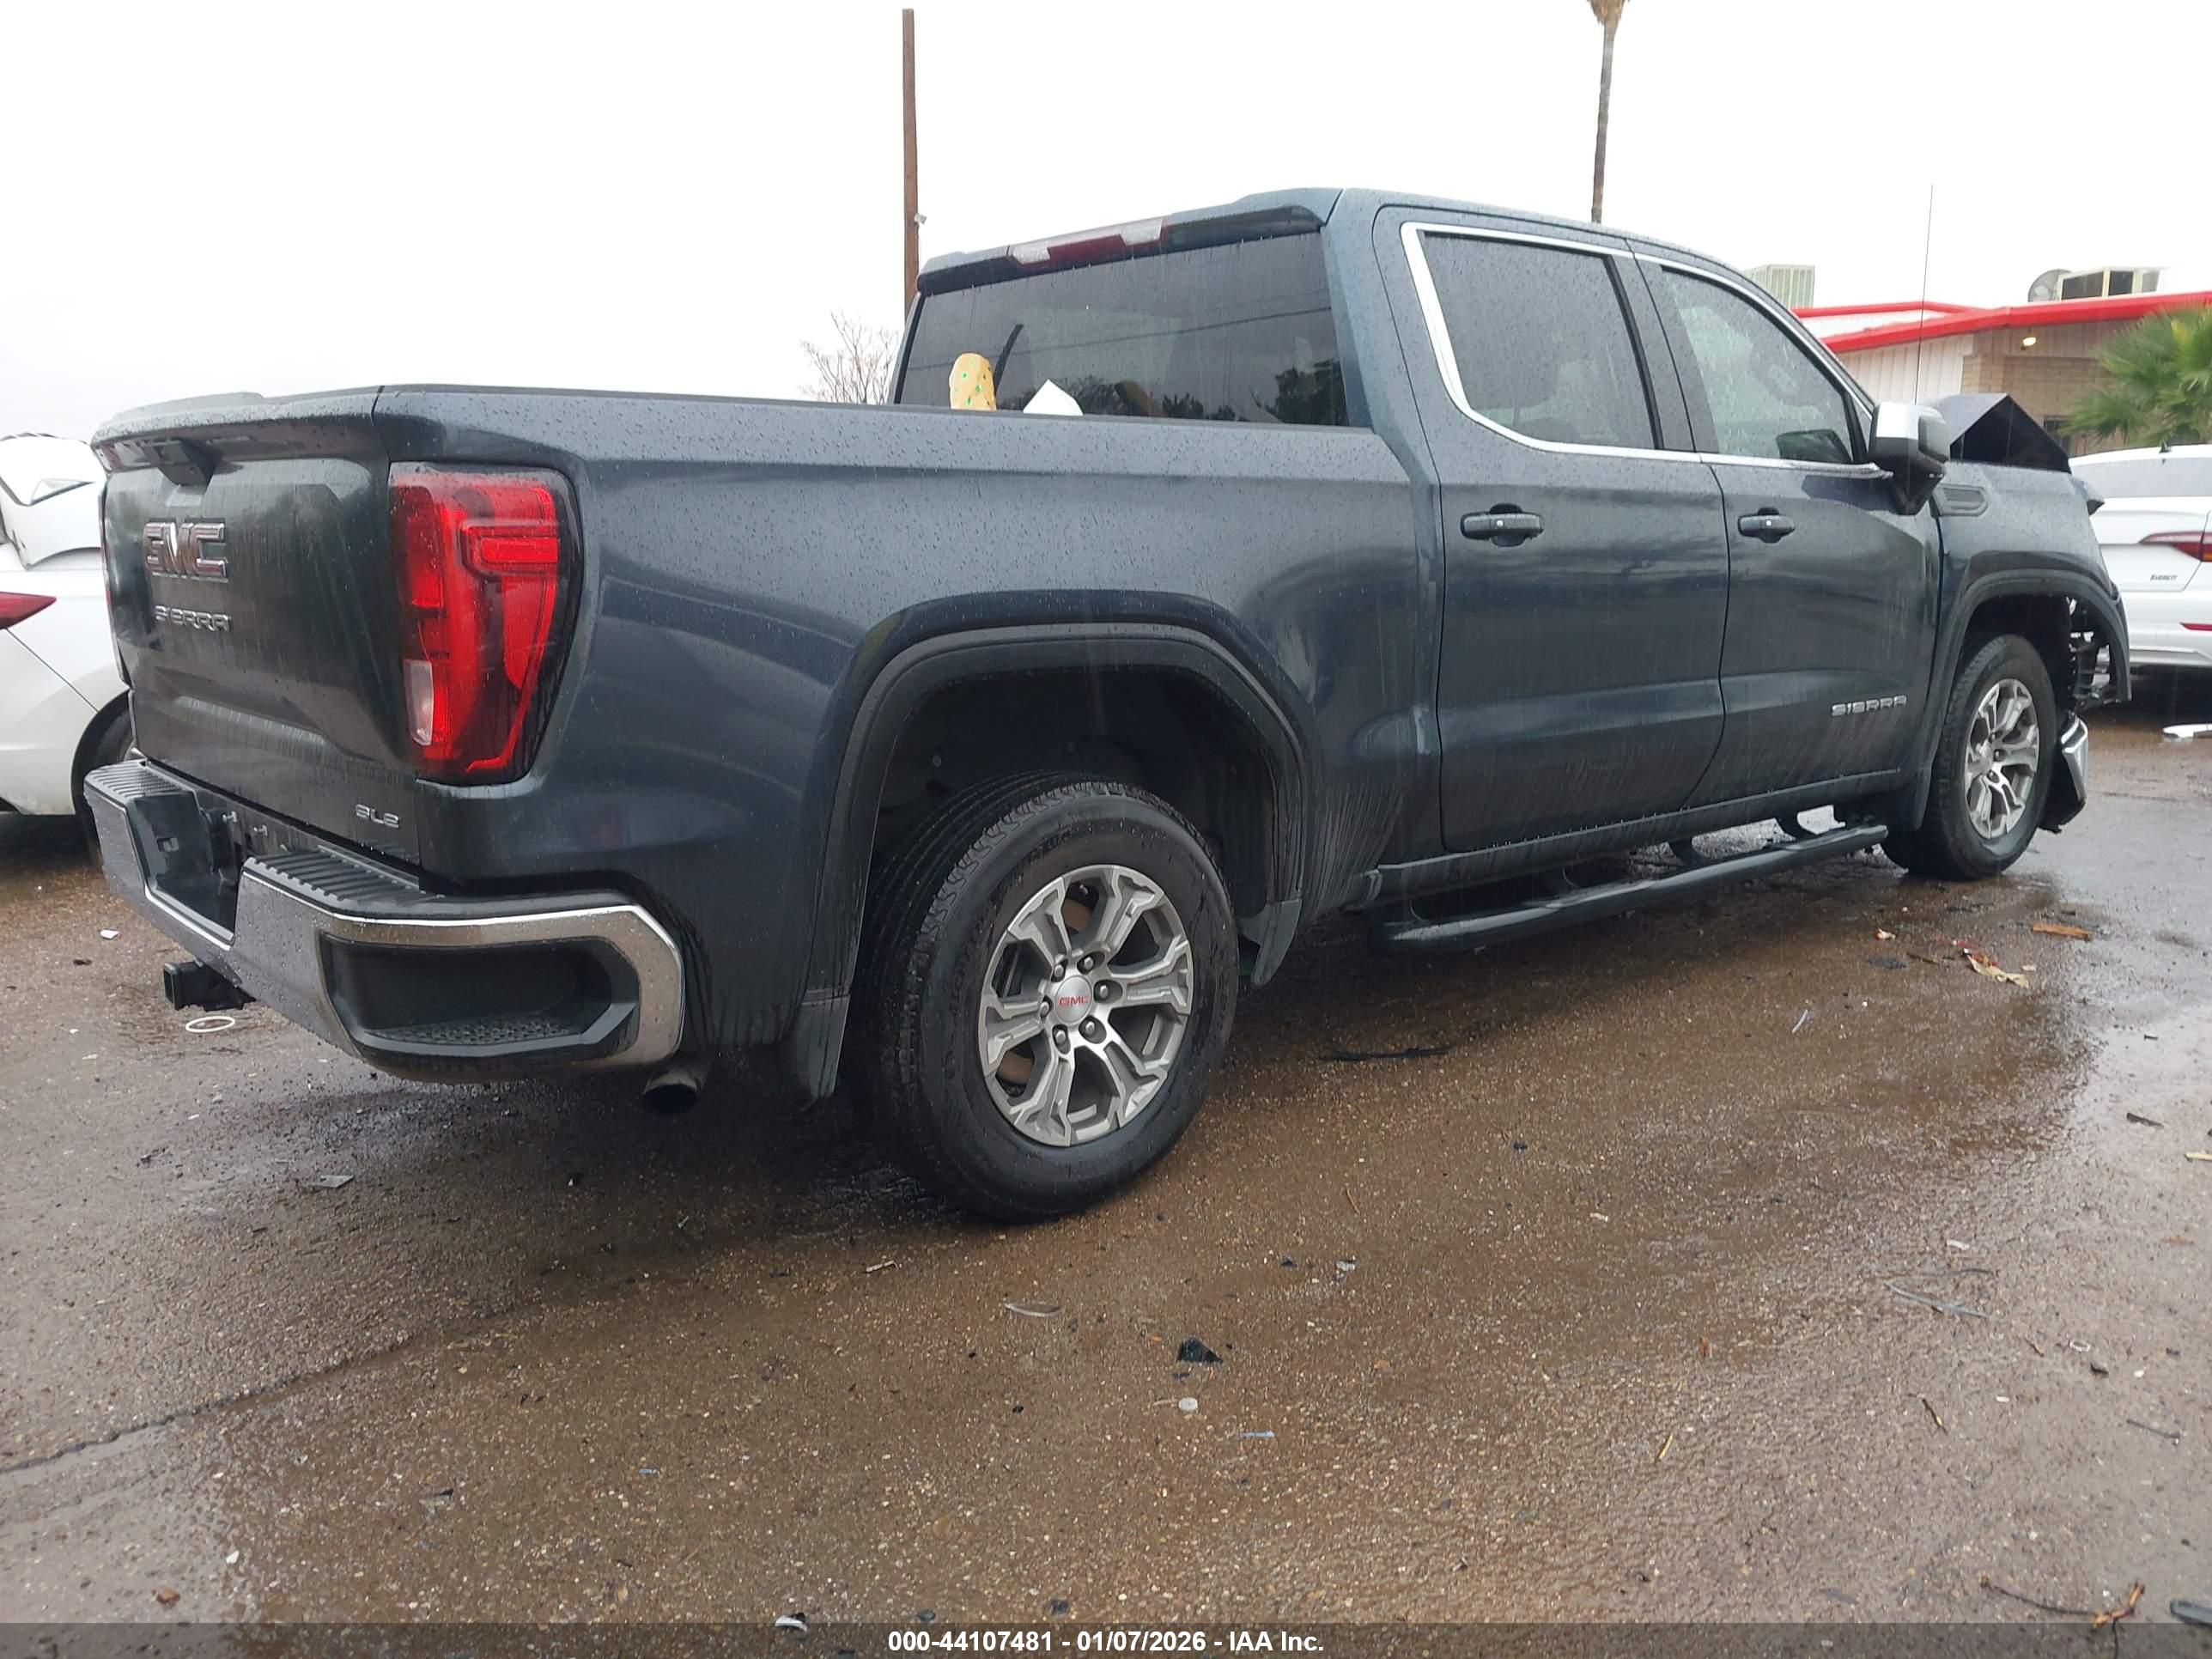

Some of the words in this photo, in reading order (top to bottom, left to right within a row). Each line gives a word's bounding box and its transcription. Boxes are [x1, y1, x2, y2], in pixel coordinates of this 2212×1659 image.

[143, 519, 229, 582] GMC
[155, 605, 231, 631] SIERRA
[1831, 694, 1907, 717] SIERRA
[355, 803, 399, 829] SLE
[1058, 995, 1090, 1006] GMC
